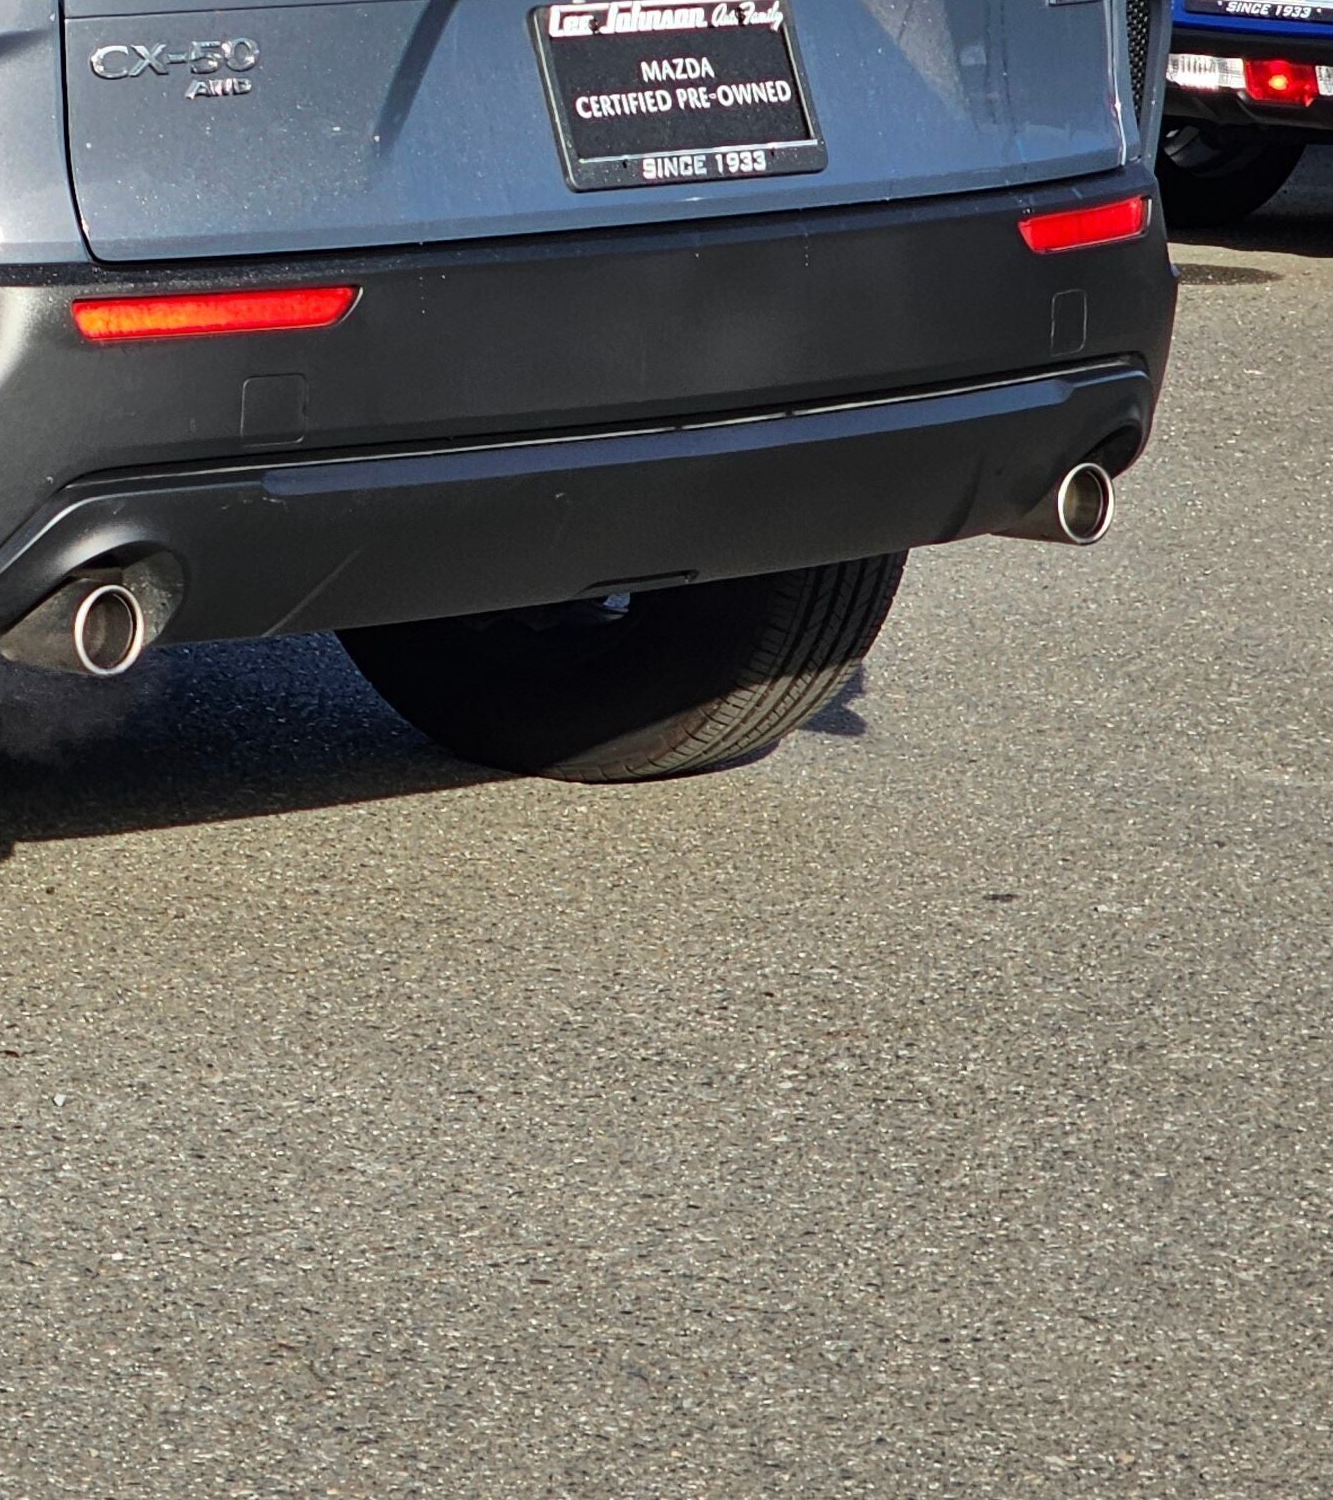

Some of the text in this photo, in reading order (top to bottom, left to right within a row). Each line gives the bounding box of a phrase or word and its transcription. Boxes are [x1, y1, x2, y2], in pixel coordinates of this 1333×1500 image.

[599, 0, 708, 35] Johnson
[1226, 1, 1312, 18] SINCE 1933
[90, 37, 260, 80] CX-50
[640, 56, 715, 83] MAZDA
[185, 77, 253, 100] AWD
[575, 80, 792, 119] CERTIFIED PRE-OWNED
[642, 150, 766, 180] SINCE 1933
